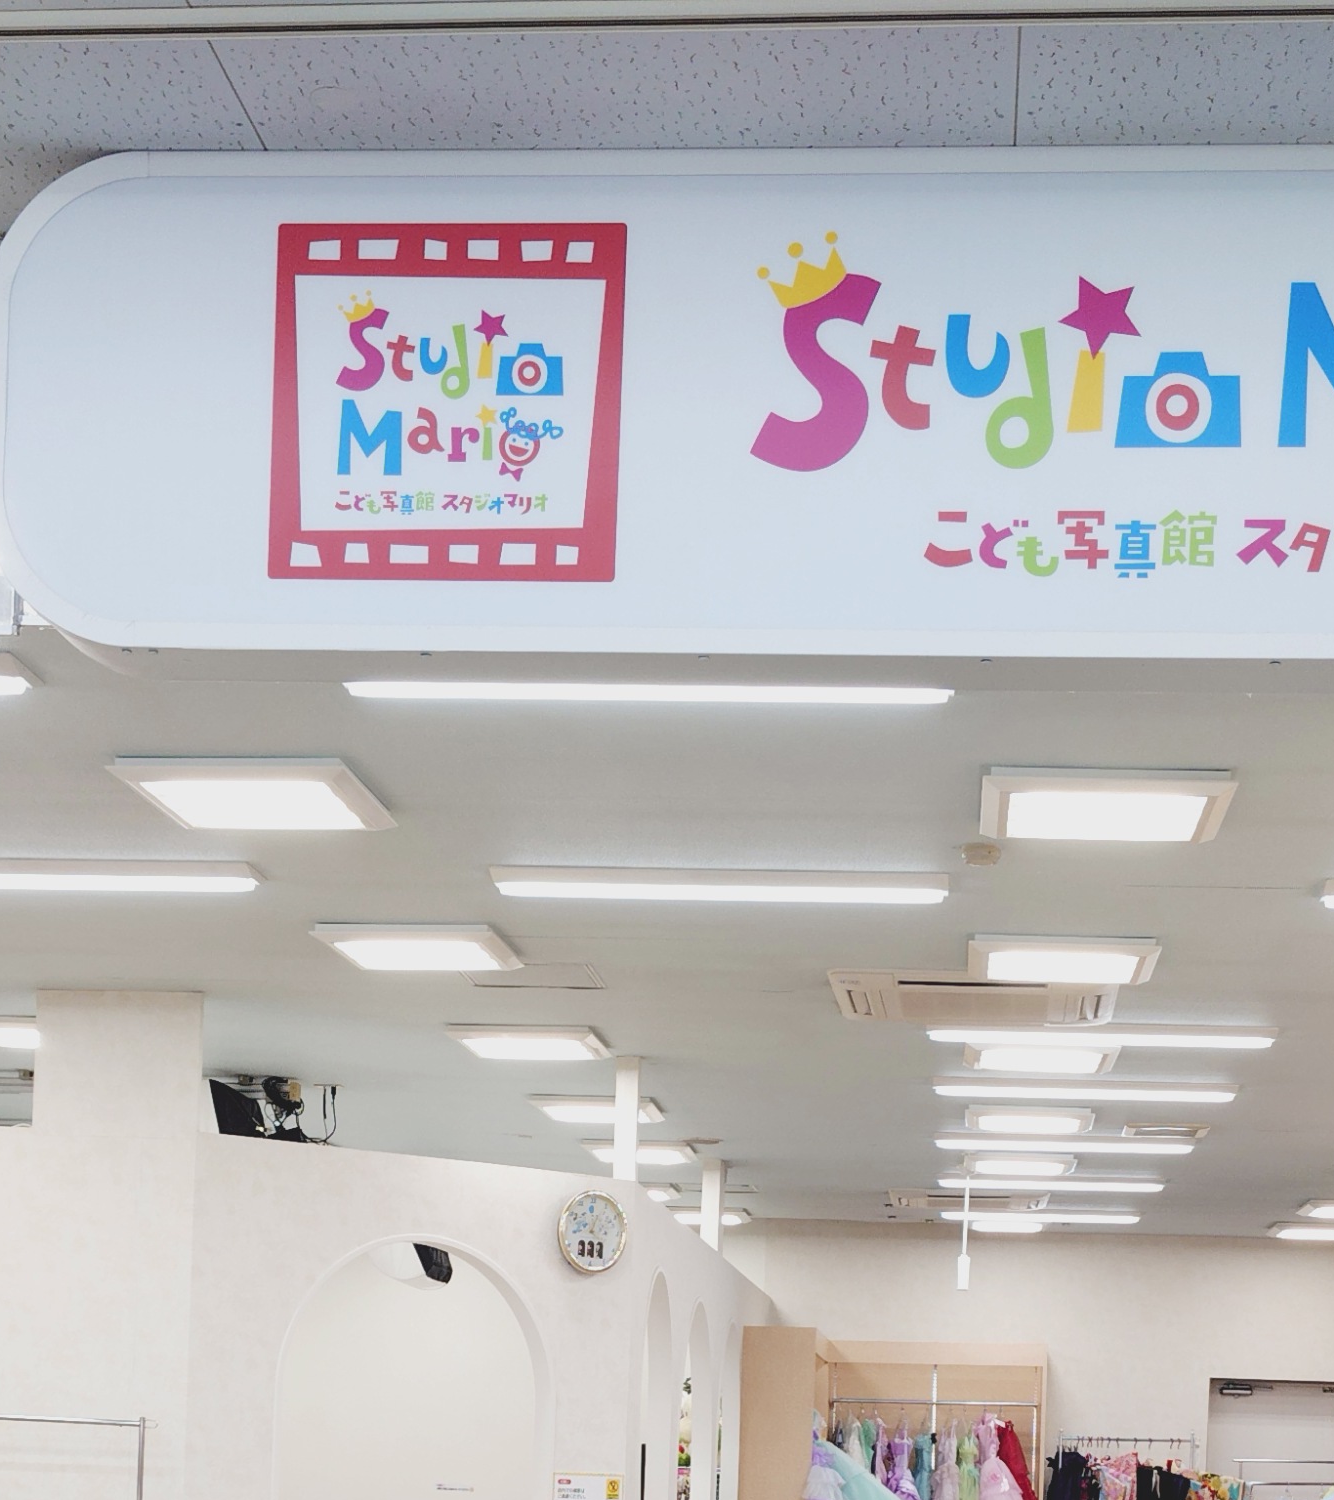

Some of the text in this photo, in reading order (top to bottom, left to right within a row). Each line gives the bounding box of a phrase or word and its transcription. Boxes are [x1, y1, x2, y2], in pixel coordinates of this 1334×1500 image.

[336, 303, 564, 399] Studio
[750, 262, 1242, 471] Studio
[337, 399, 557, 478] Mario
[334, 490, 549, 516] こども写真館 スタジオマリオ
[923, 509, 1216, 577] こども写真館
